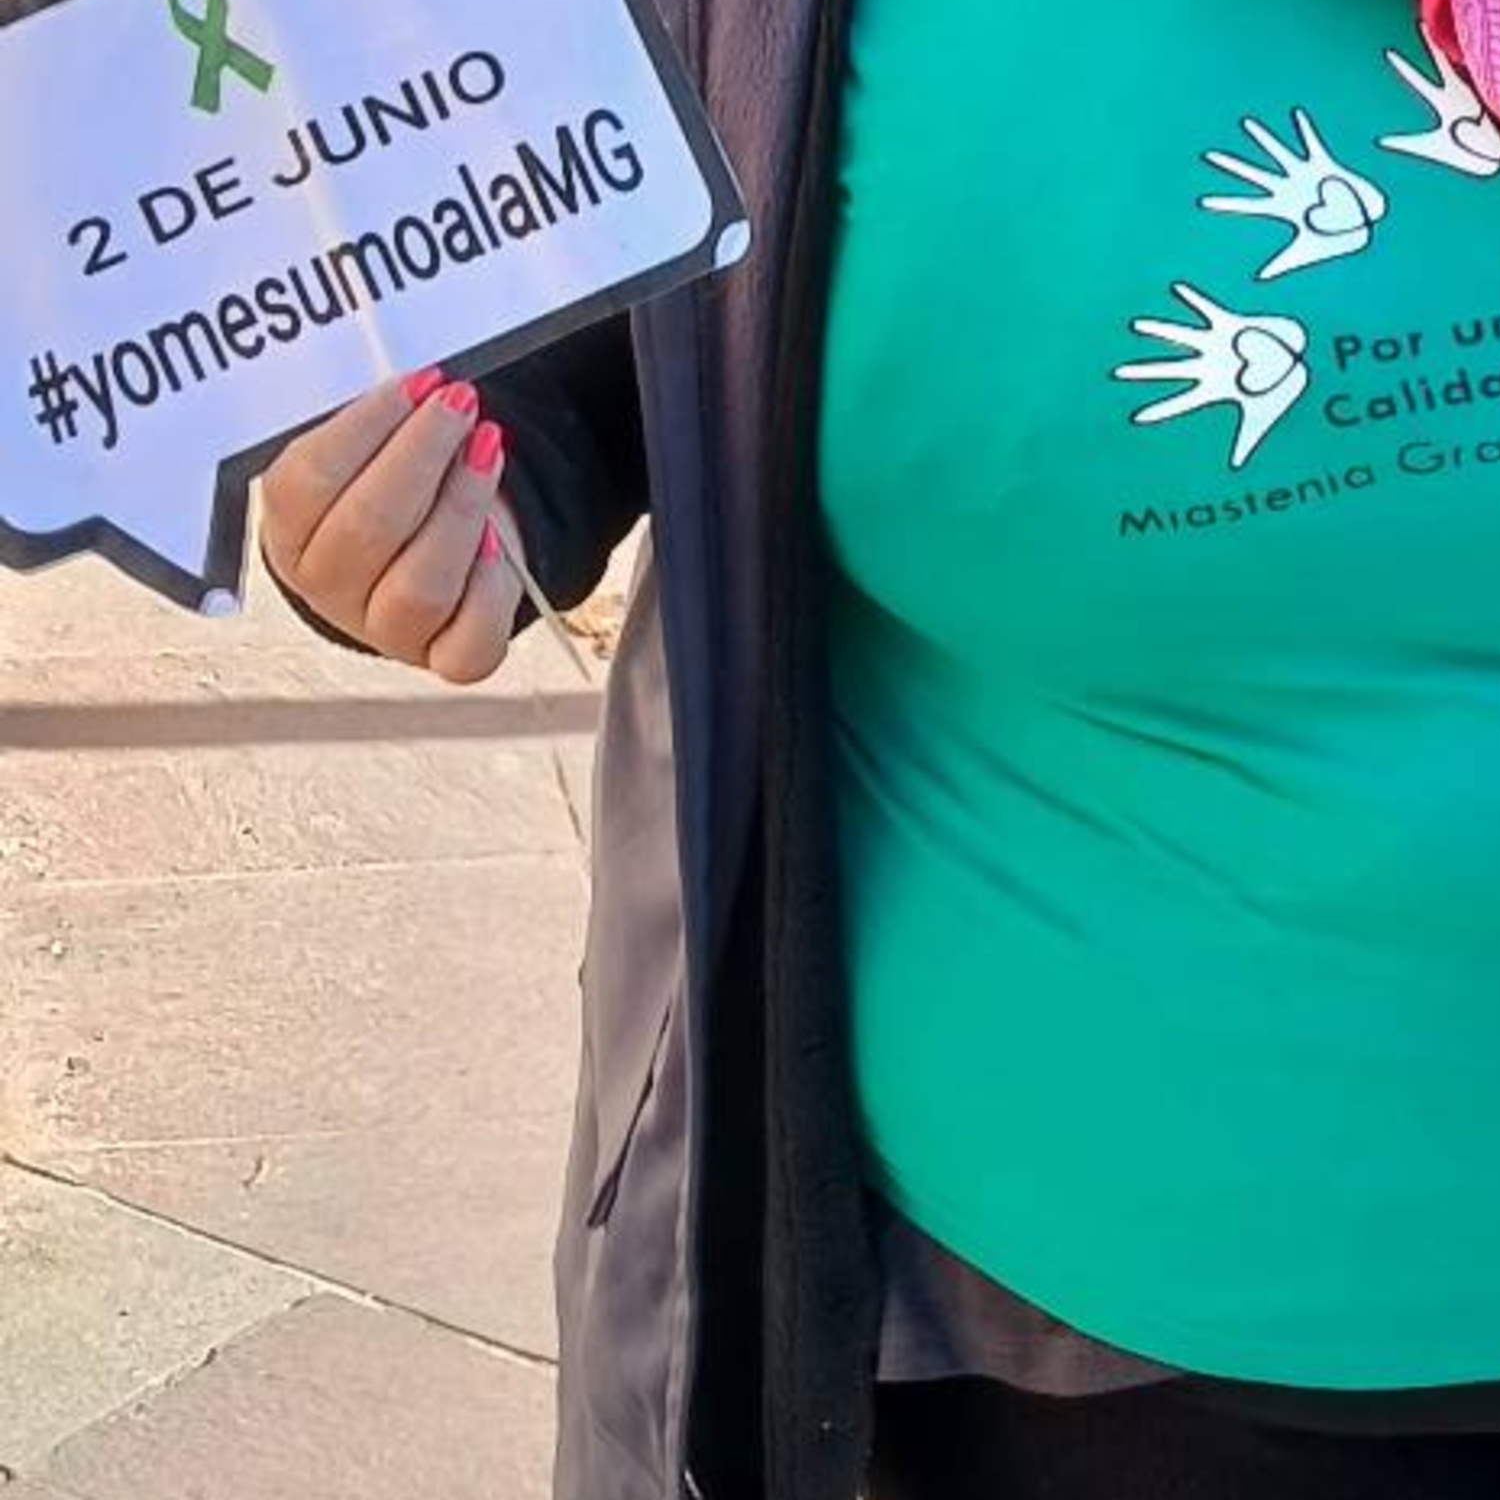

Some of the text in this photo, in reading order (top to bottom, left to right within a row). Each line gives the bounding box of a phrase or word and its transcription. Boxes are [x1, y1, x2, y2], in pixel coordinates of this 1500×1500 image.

[67, 49, 507, 276] 2 DE JUNIO
[27, 107, 646, 450] #yomesumoalaMG
[1332, 331, 1423, 371] Por
[1117, 461, 1378, 540] Miastenia
